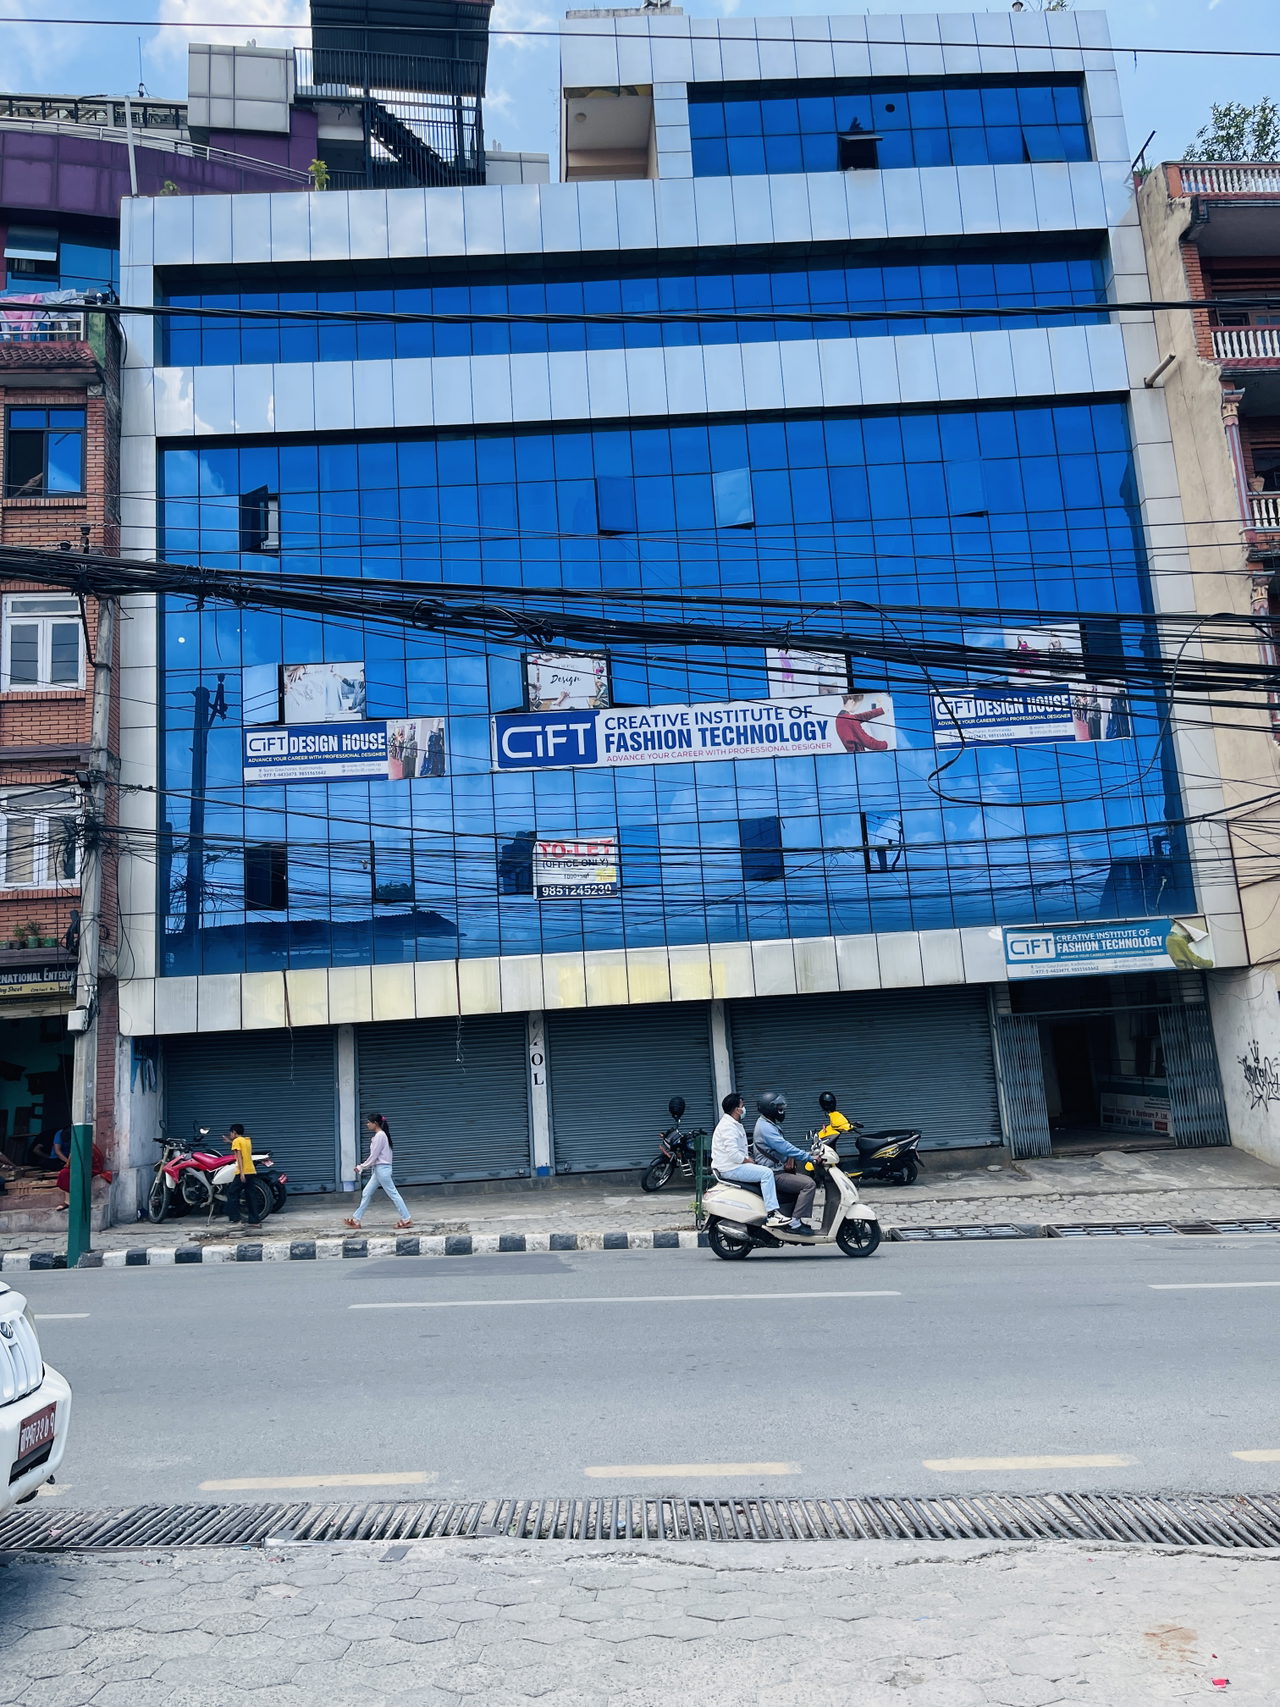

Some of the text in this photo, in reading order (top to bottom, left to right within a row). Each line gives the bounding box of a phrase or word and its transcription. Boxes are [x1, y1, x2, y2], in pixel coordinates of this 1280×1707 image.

[550, 674, 582, 686] Design
[976, 697, 1024, 717] DESIGN
[1027, 694, 1070, 714] HOUSE
[604, 705, 813, 730] CREATIVE INSTITUTE OF
[289, 734, 338, 754] DESIGN
[342, 732, 386, 751] HOUSE
[604, 720, 829, 753] FASHION TECHNOLOGY
[606, 742, 832, 763] ADVANCE YOUR CAREER WITH PROFESSIONAL DESIGNER
[538, 840, 613, 858] TO-LET
[543, 859, 579, 869] (OFFICE
[542, 884, 612, 896] 9851245230
[1056, 928, 1151, 943] CREATIVE INSTITUTE OF
[1056, 936, 1163, 953] FASHION TECHNOLOGY
[0, 972, 42, 984] NATIONAL
